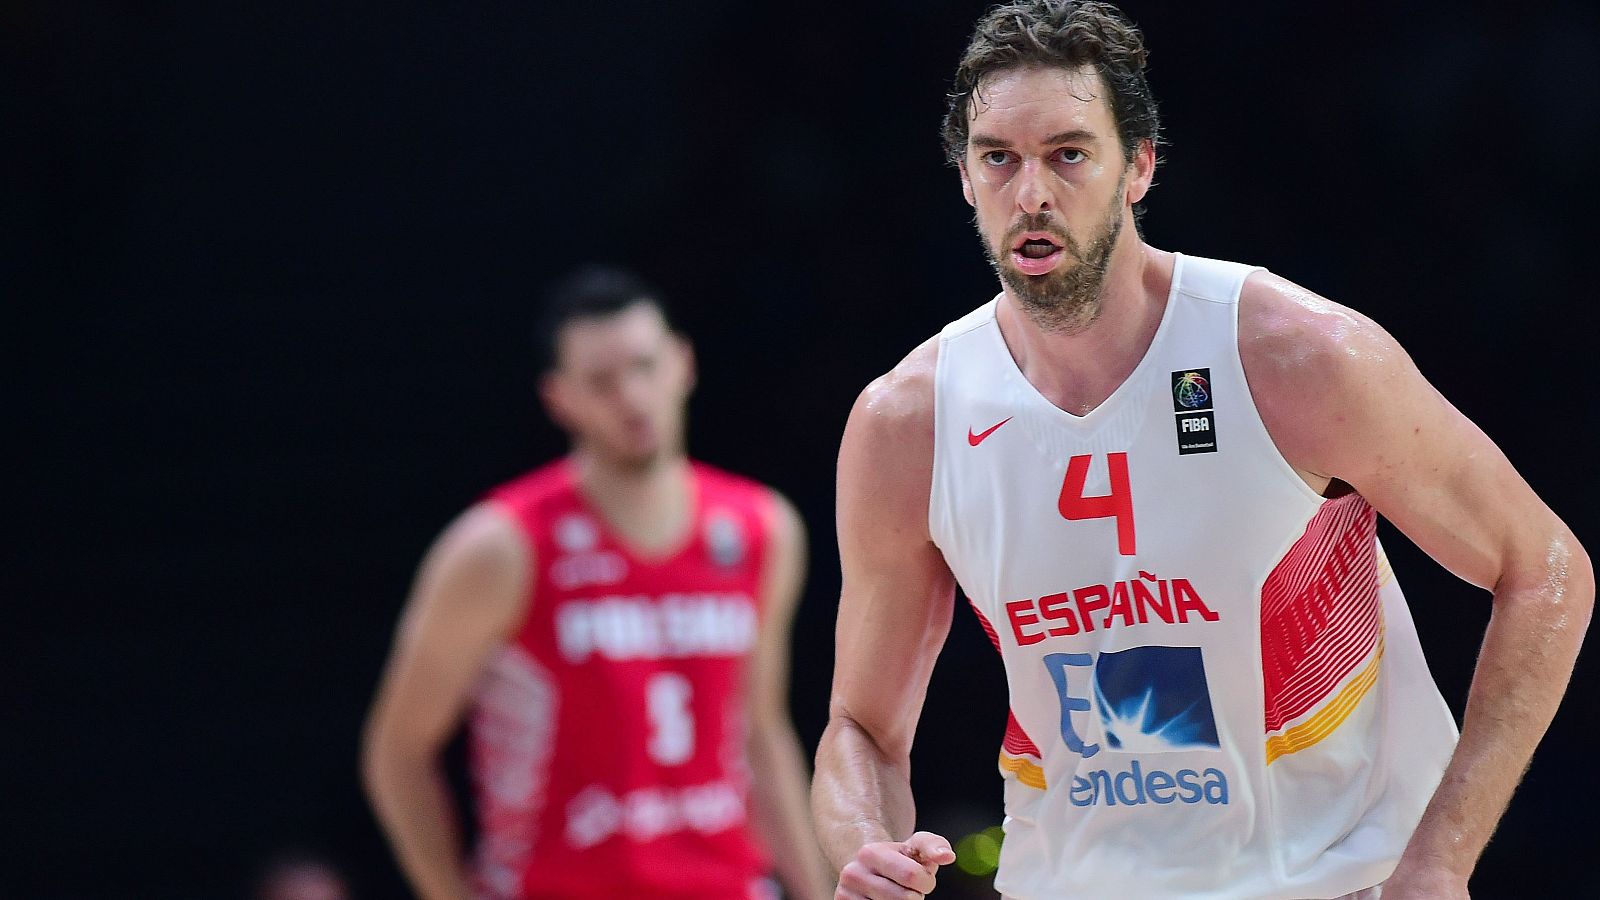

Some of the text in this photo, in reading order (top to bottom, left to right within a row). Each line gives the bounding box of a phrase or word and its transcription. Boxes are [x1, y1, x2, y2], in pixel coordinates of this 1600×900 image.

[1181, 417, 1210, 433] FIBA
[1058, 451, 1136, 556] 4
[1005, 570, 1220, 647] ESPAÑA
[1069, 760, 1229, 807] endesa
